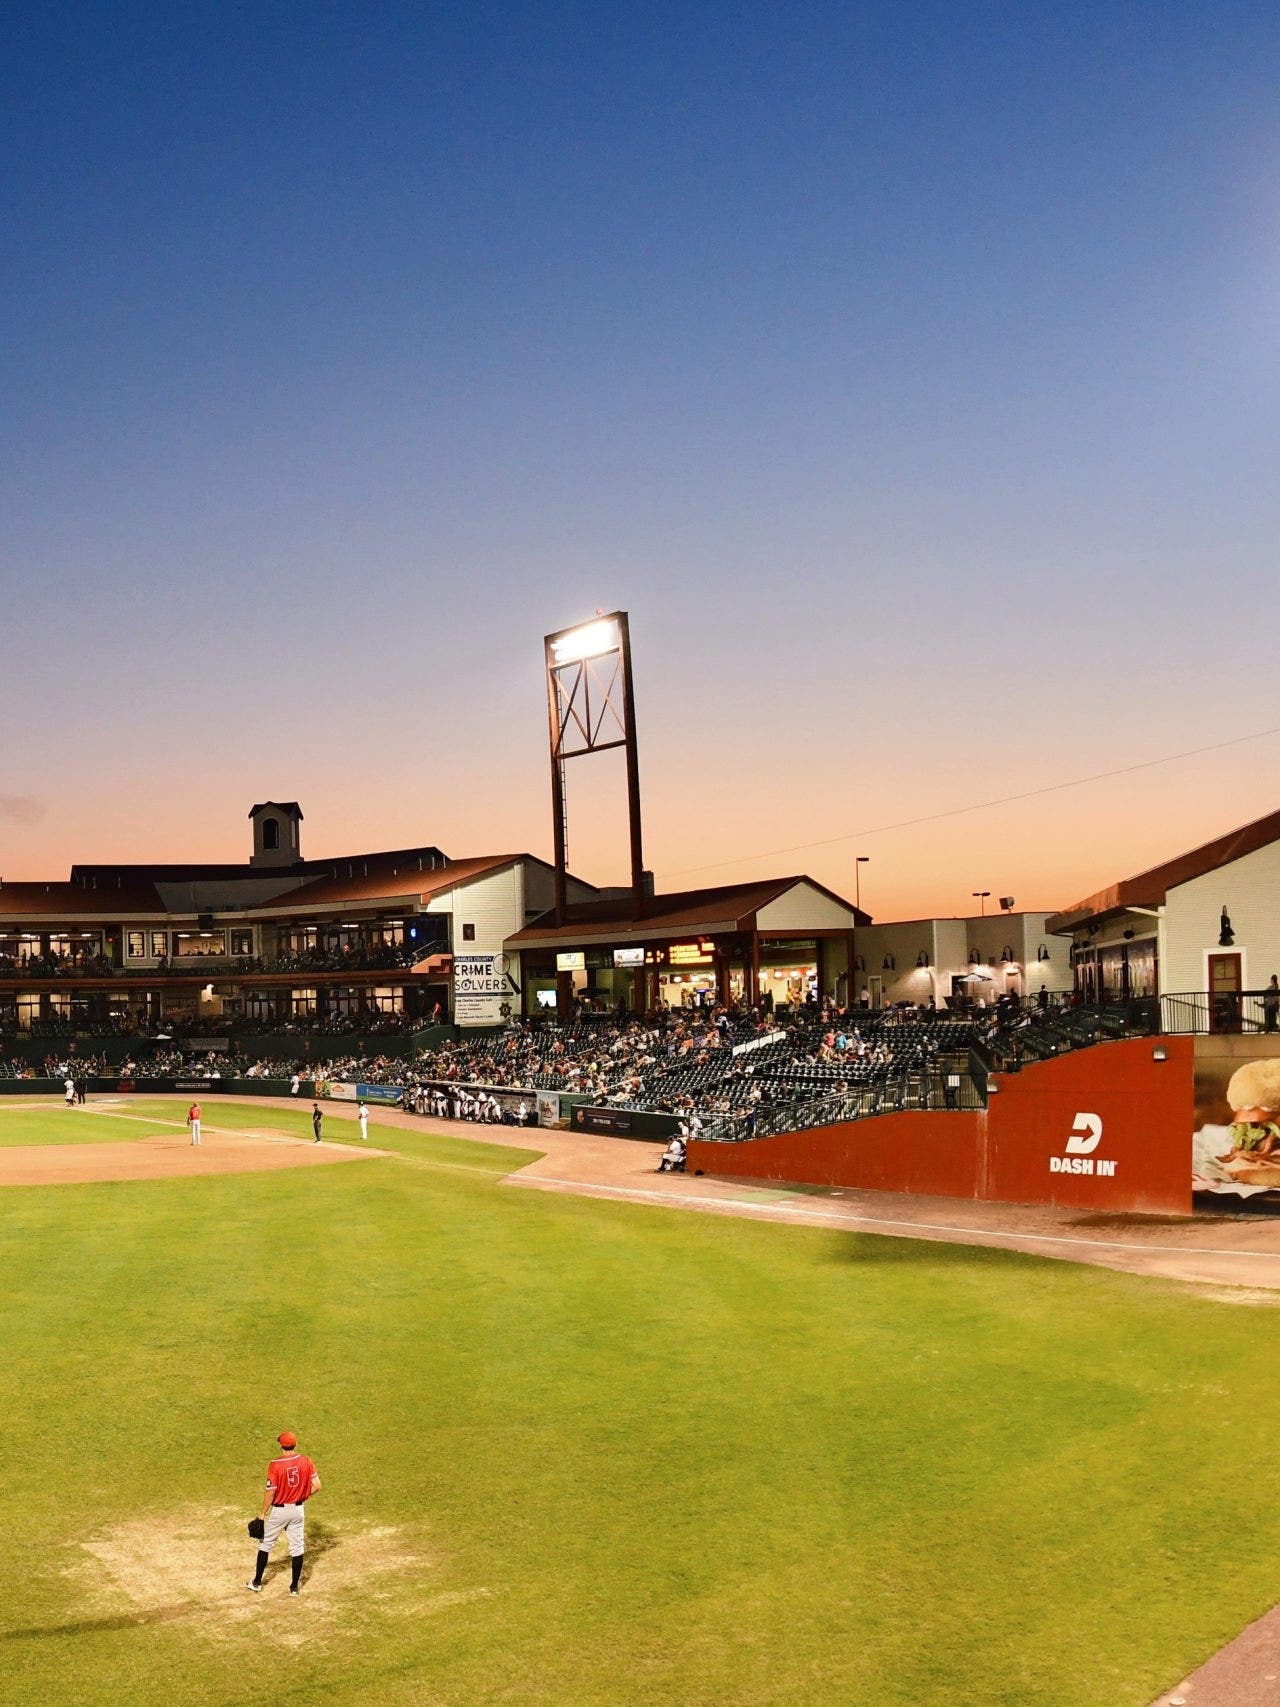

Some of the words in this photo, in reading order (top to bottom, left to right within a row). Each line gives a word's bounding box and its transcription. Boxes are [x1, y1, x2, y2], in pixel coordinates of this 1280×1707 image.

[454, 965, 492, 976] CRIME
[454, 979, 507, 990] SOLVERS
[1049, 1157, 1094, 1175] DASH
[286, 1466, 300, 1488] 5
